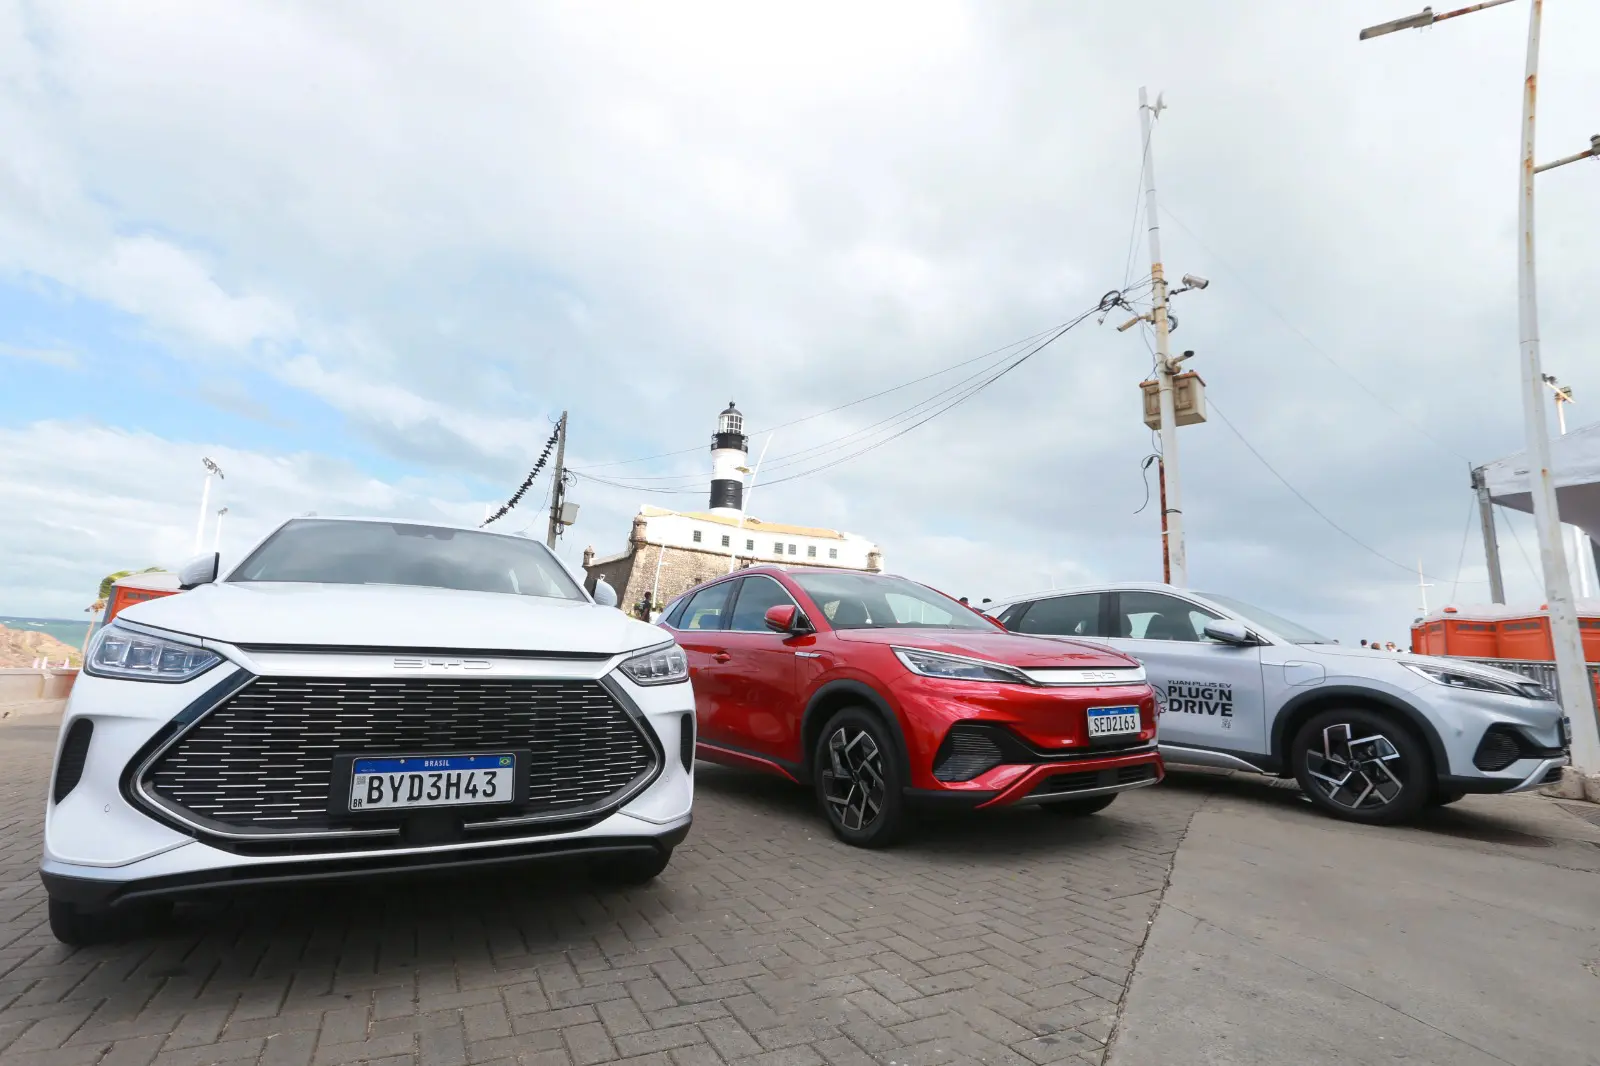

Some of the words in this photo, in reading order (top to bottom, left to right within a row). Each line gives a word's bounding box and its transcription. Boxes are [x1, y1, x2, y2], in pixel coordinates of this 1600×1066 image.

[394, 658, 492, 669] BYD
[1168, 686, 1232, 701] PLUG'N
[1169, 698, 1233, 717] DRIVE
[424, 759, 450, 767] BRASIL
[367, 771, 497, 804] BYD3H43
[353, 798, 363, 808] BR
